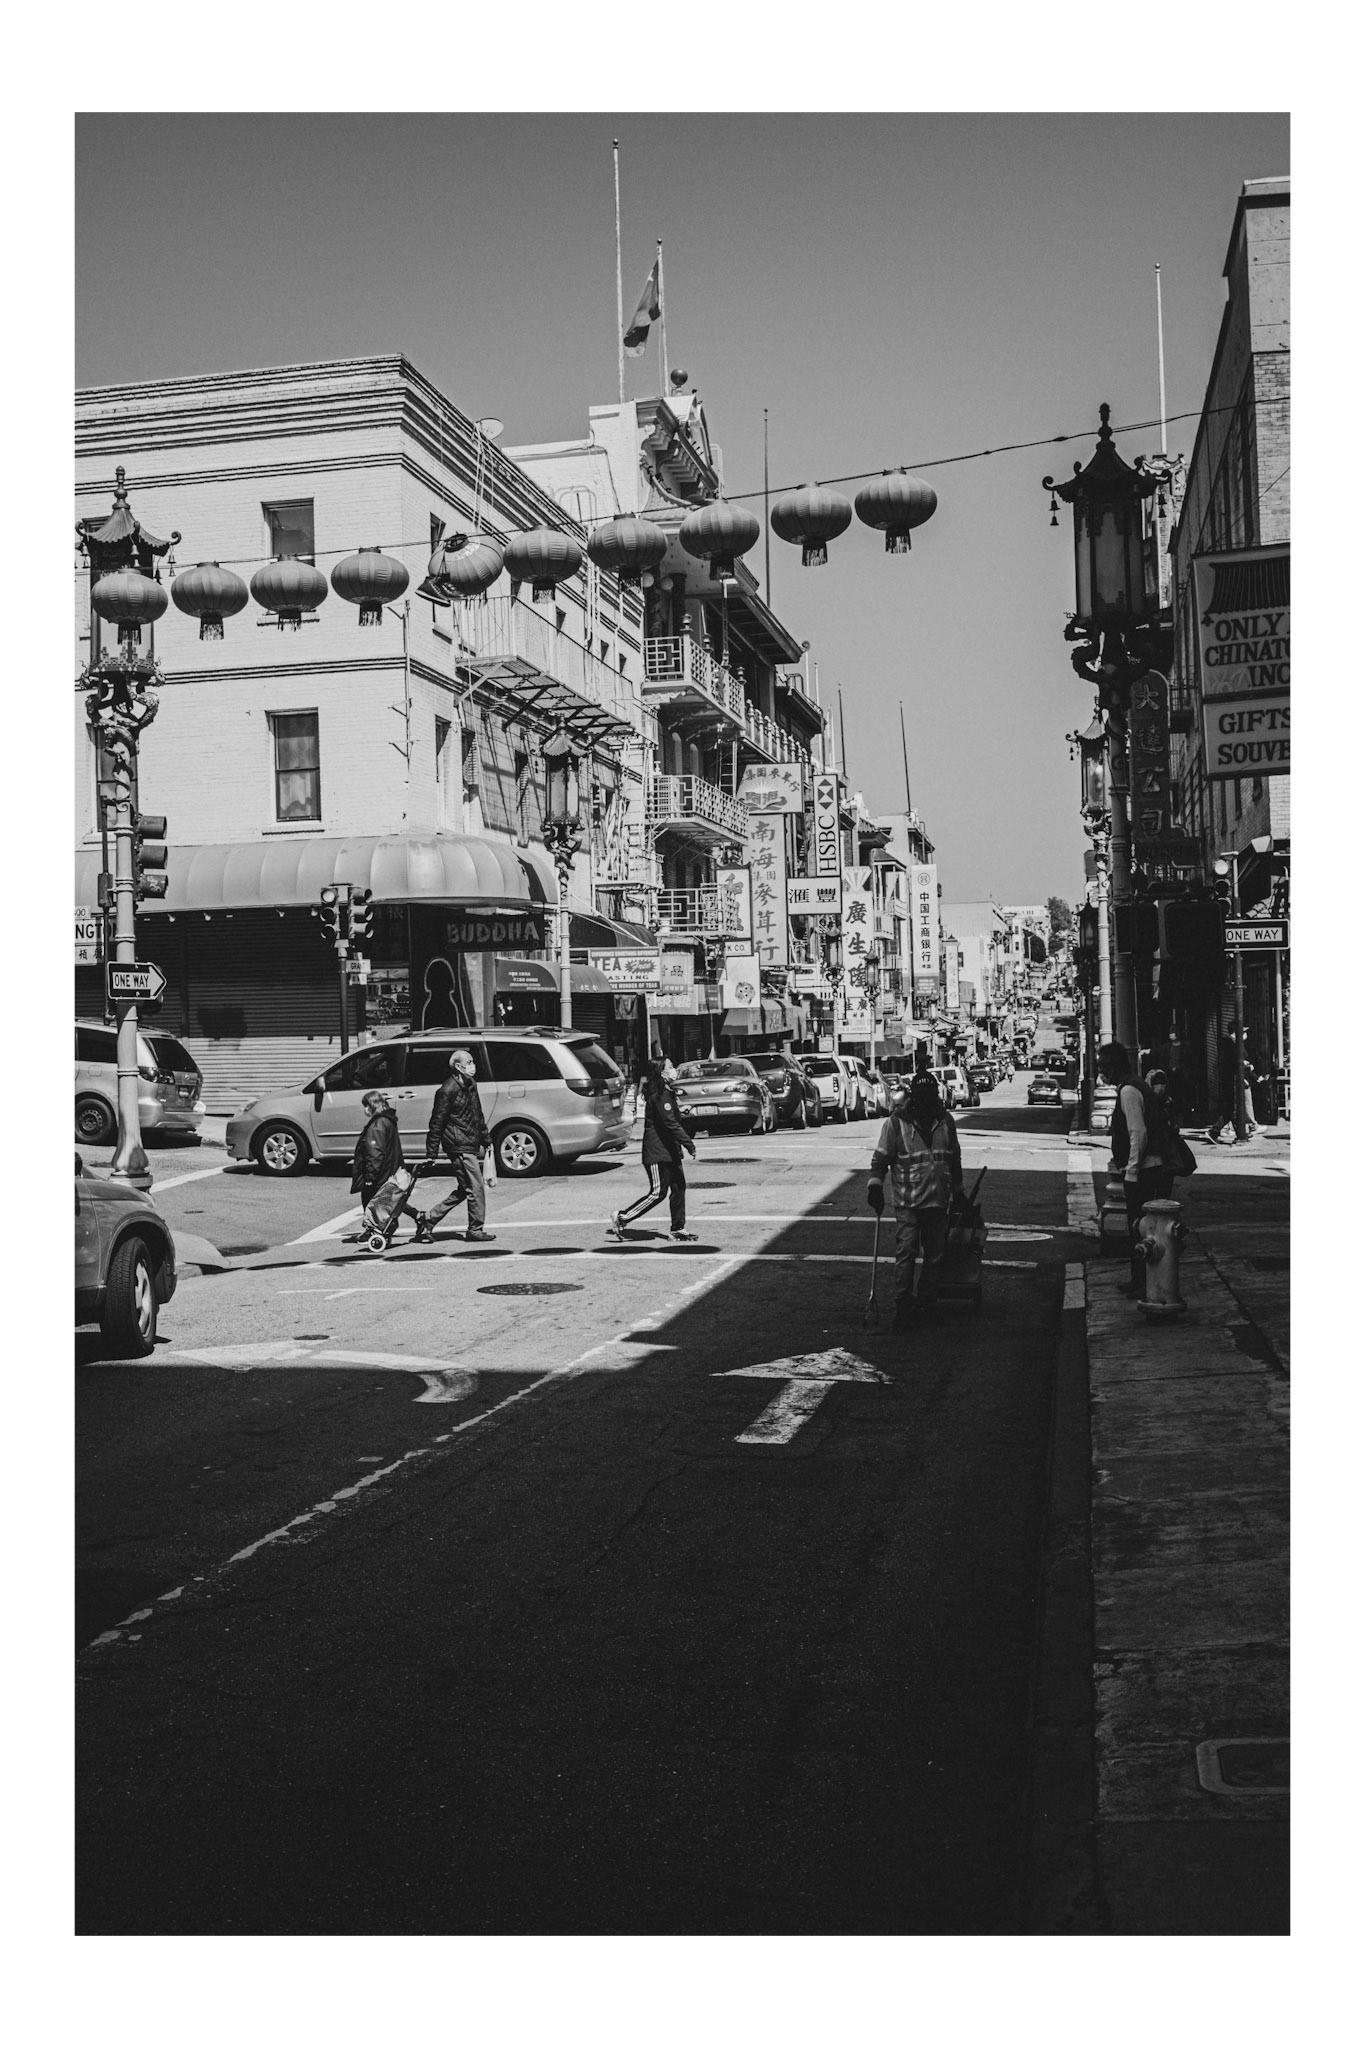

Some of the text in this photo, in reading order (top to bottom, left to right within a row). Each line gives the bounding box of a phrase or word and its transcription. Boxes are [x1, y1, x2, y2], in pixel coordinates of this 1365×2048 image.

[1214, 612, 1285, 642] ONLY
[1218, 707, 1290, 734] GIFTS
[1217, 739, 1290, 766] SOUVE
[818, 815, 837, 873] HSBC
[447, 920, 540, 944] BUDDHA
[1226, 929, 1279, 941] ONE WAY
[591, 957, 622, 971] TEA
[114, 974, 149, 987] ONE WAY
